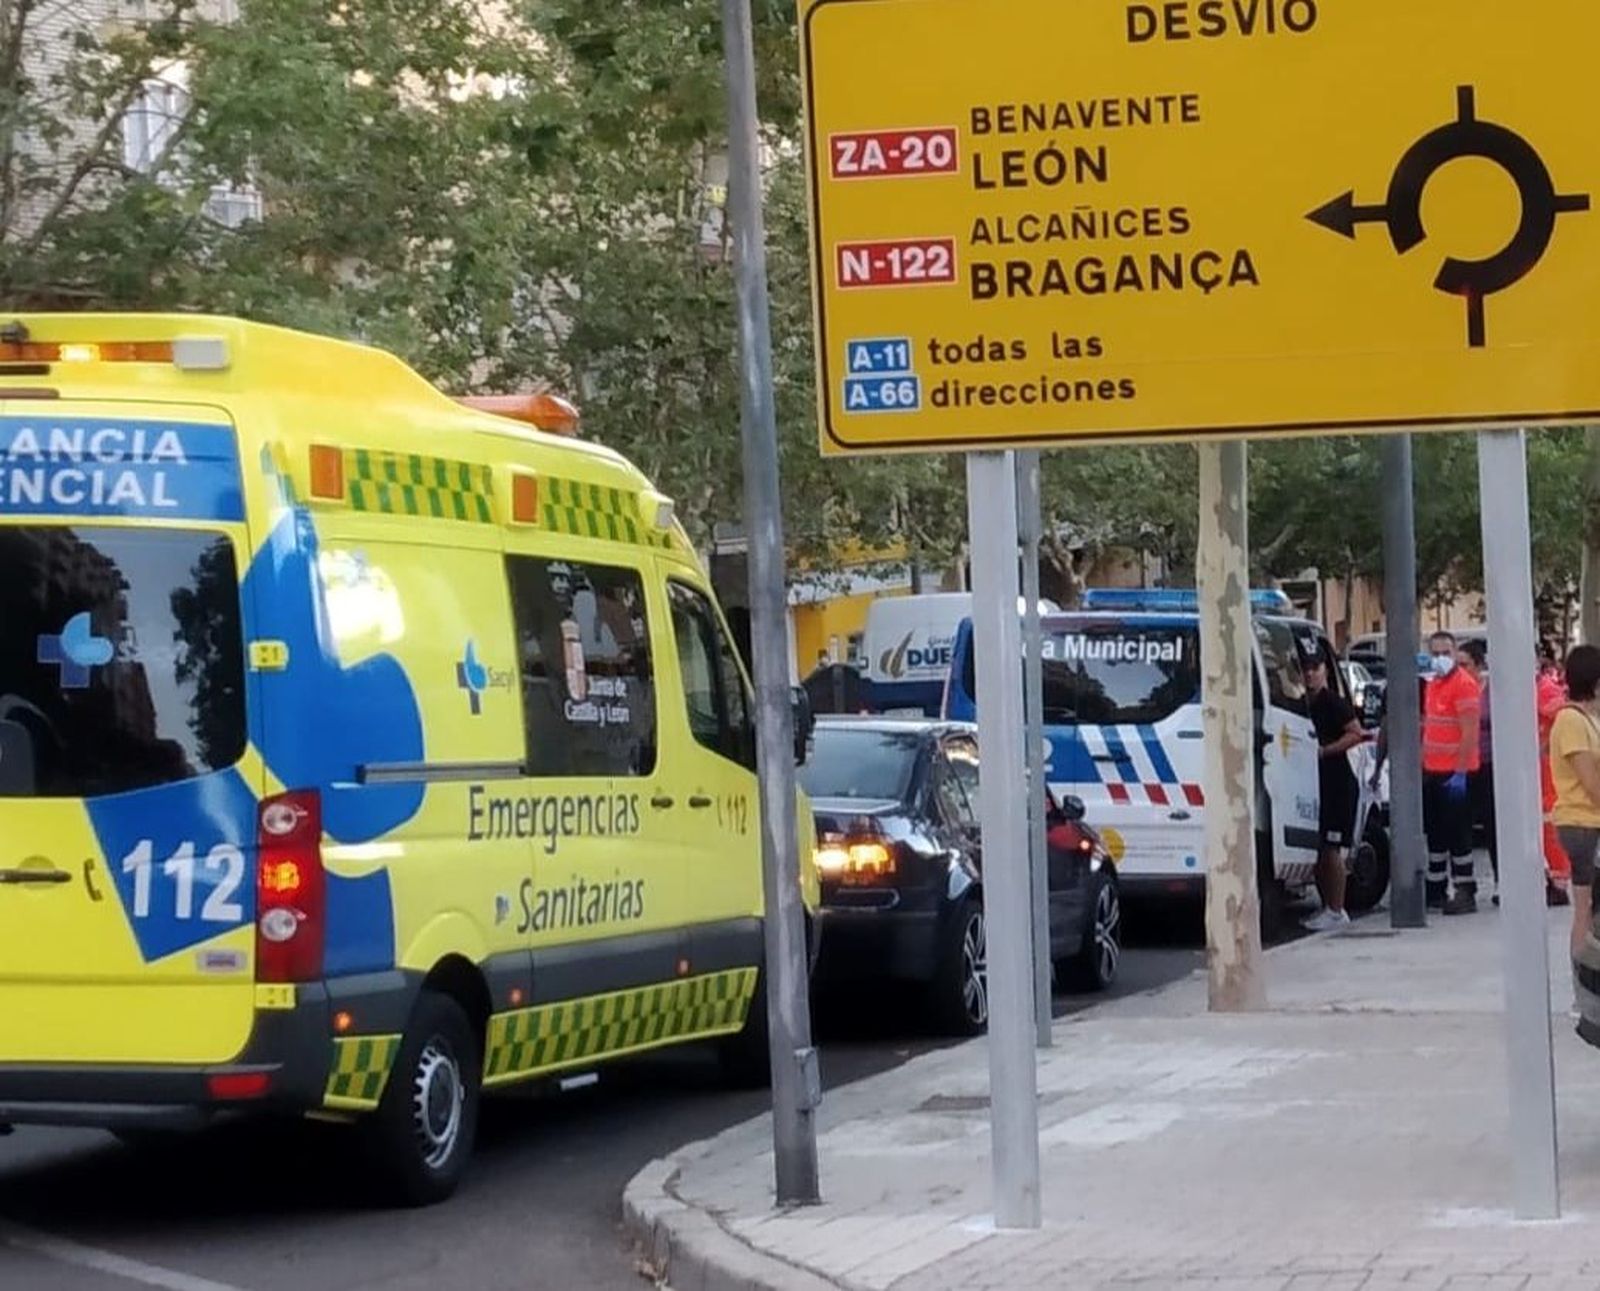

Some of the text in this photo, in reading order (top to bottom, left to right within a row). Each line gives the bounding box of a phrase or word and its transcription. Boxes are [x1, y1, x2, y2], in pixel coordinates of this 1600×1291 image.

[1126, 0, 1318, 42] DESVIO
[970, 94, 1200, 136] BENAVENTE
[836, 135, 952, 173] ZA-20
[972, 141, 1109, 189] LEÓN
[969, 206, 1191, 245] ALCAÑICES
[841, 244, 951, 282] N-122
[970, 249, 1260, 300] BRAGANÇA
[852, 344, 908, 368] A-11
[927, 331, 1103, 364] todas las
[848, 380, 915, 406] A-66
[930, 376, 1136, 408] direcciones
[0, 427, 188, 465] ANCIA
[1063, 634, 1183, 663] Municipal
[468, 783, 640, 854] Emergencias
[727, 795, 748, 835] 112
[122, 839, 245, 922] 112
[516, 870, 645, 934] Sanitarias
